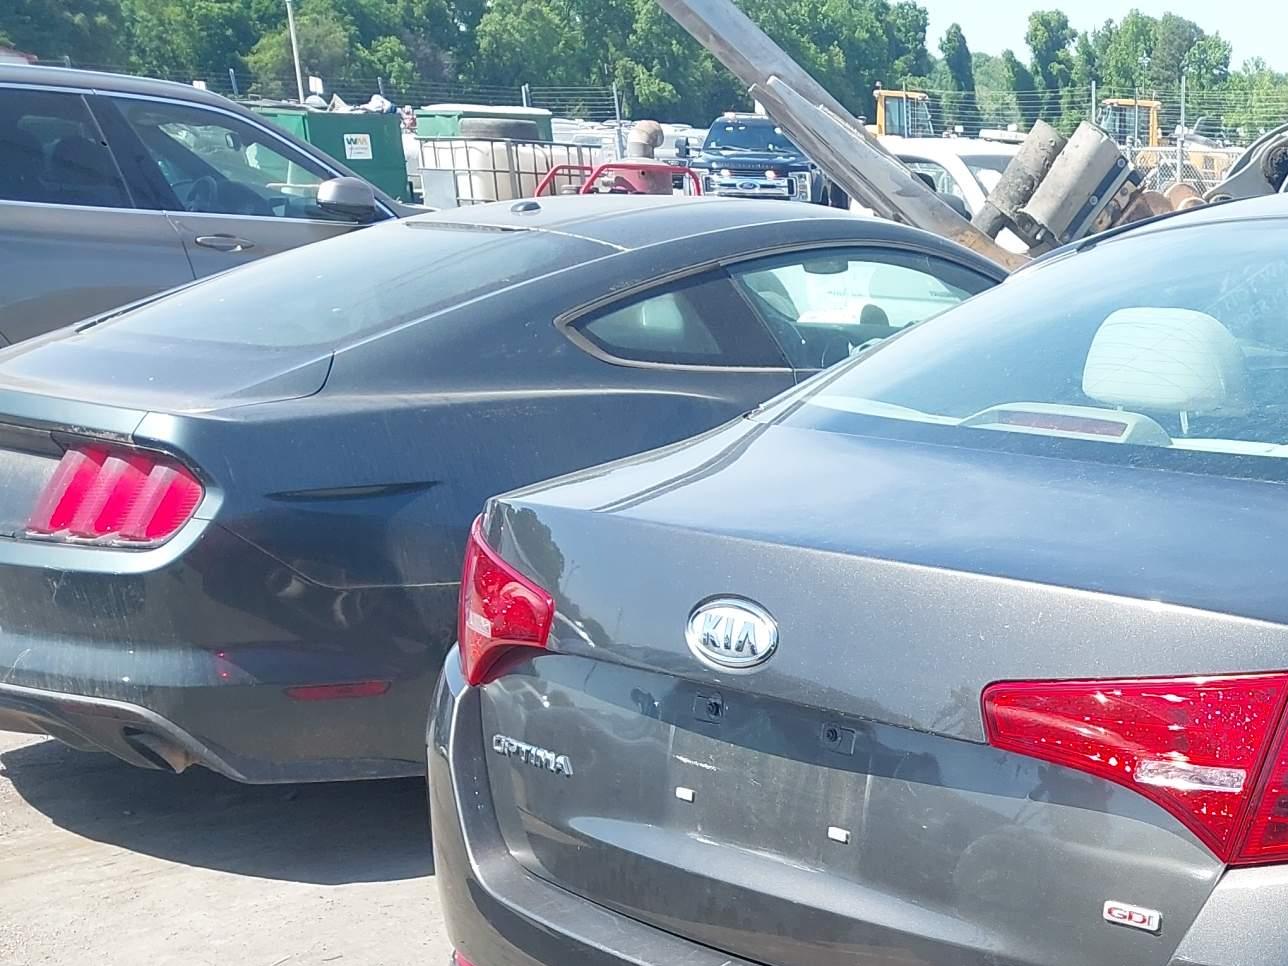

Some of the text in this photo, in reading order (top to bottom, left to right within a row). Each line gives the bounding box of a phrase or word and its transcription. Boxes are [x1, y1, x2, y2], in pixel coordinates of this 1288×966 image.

[702, 613, 758, 656] KIA
[493, 733, 574, 776] OPTIMA
[1107, 906, 1154, 927] GDI
